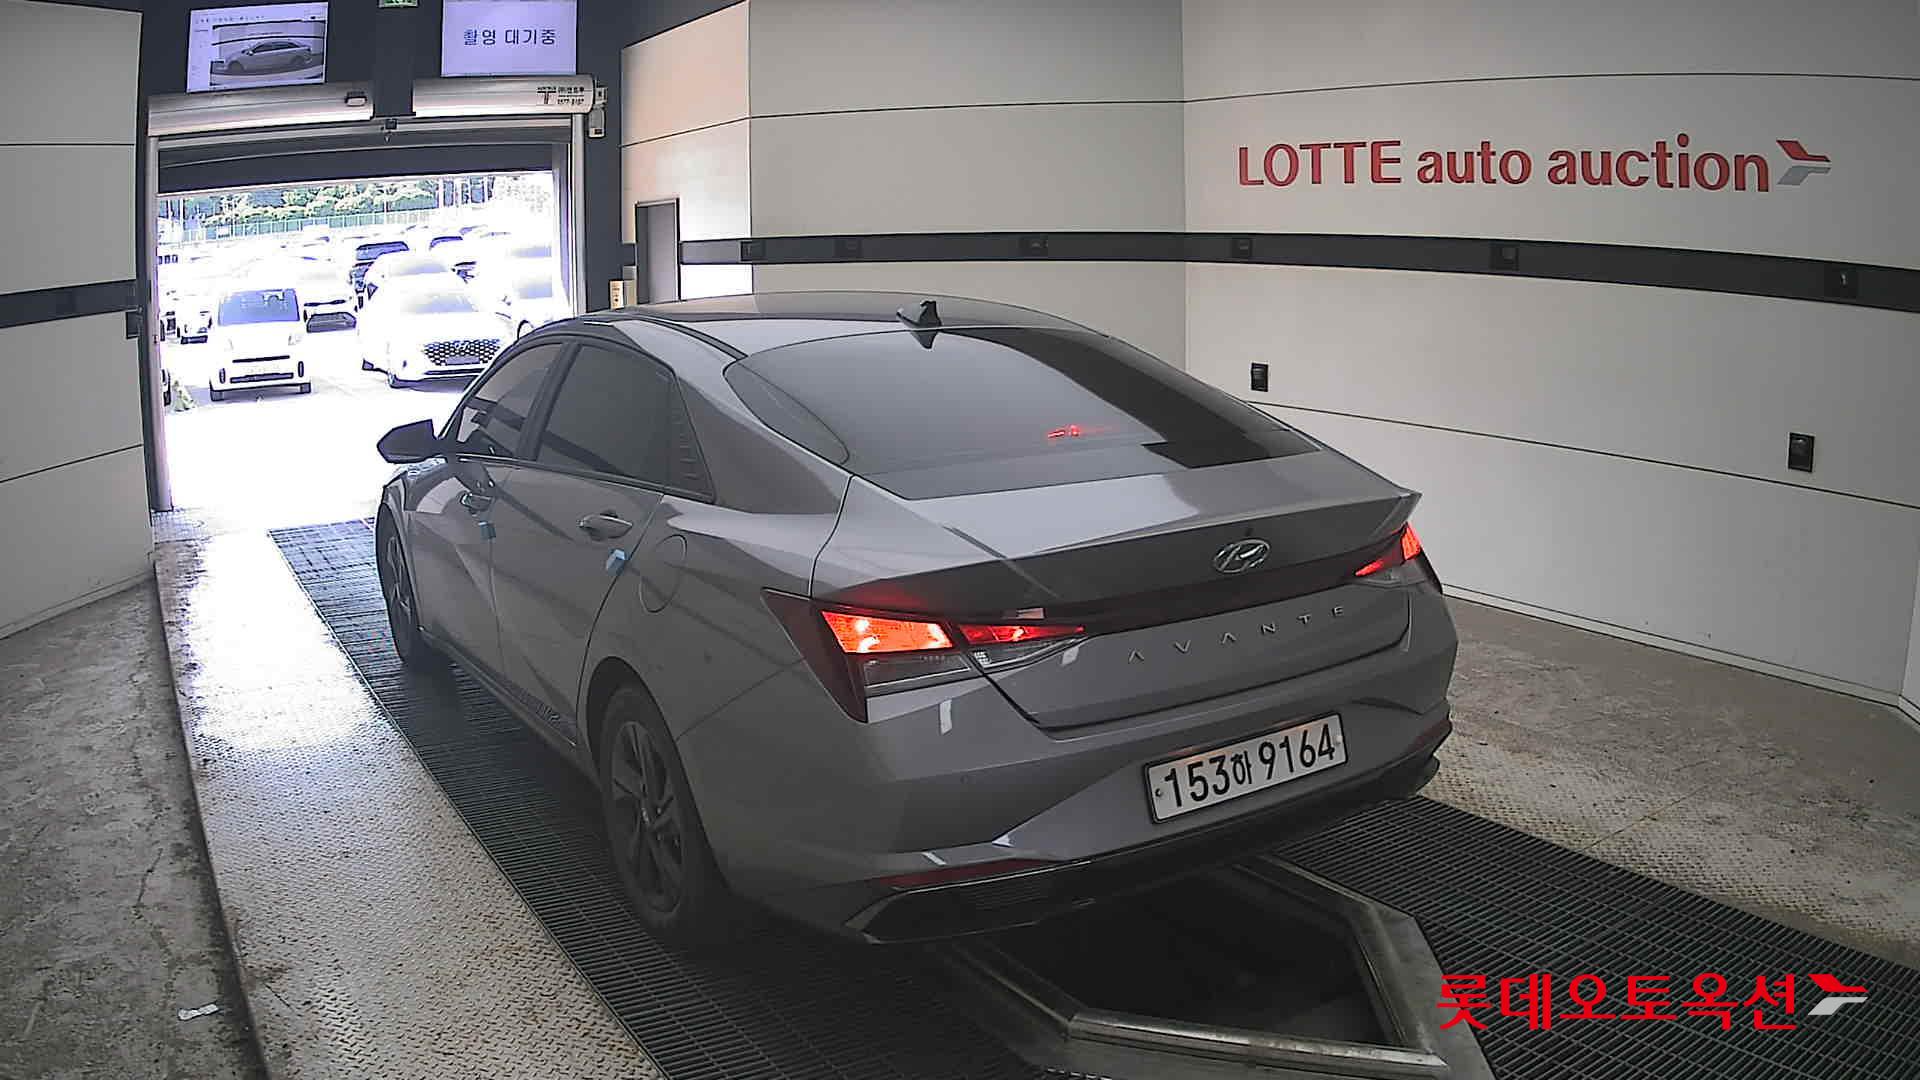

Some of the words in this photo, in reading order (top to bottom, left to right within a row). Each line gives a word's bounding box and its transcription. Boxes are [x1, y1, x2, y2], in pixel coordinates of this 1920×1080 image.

[504, 28, 556, 45] 대기중
[1238, 140, 1401, 187] LOTTE
[1417, 141, 1532, 185] auto
[1547, 132, 1769, 193] auction
[1127, 606, 1344, 664] AVANTE
